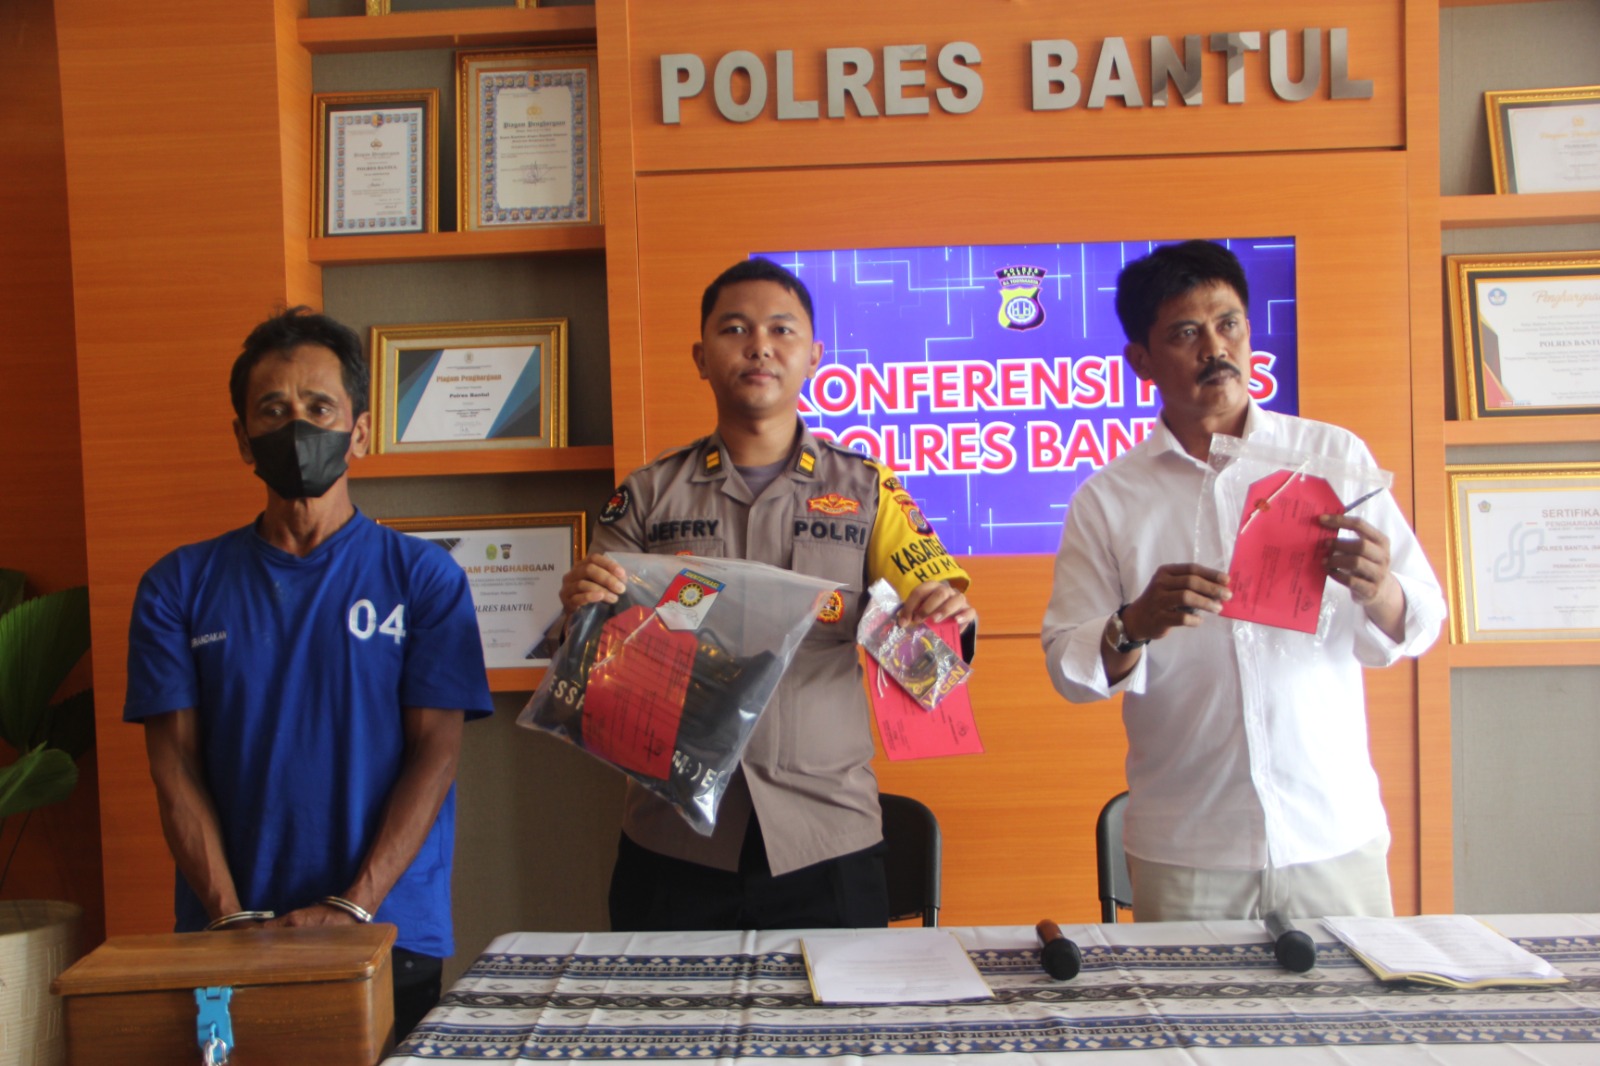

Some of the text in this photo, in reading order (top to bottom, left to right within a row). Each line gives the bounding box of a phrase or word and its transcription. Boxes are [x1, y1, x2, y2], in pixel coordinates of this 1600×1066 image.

[660, 27, 1374, 124] POLRES BANTUL
[1027, 417, 1156, 473] BAN
[648, 519, 719, 542] JEFFRY
[794, 519, 866, 545] POLRI
[484, 564, 555, 573] PENGHARGAAN
[499, 603, 534, 612] BANTUL
[349, 598, 407, 645] 04
